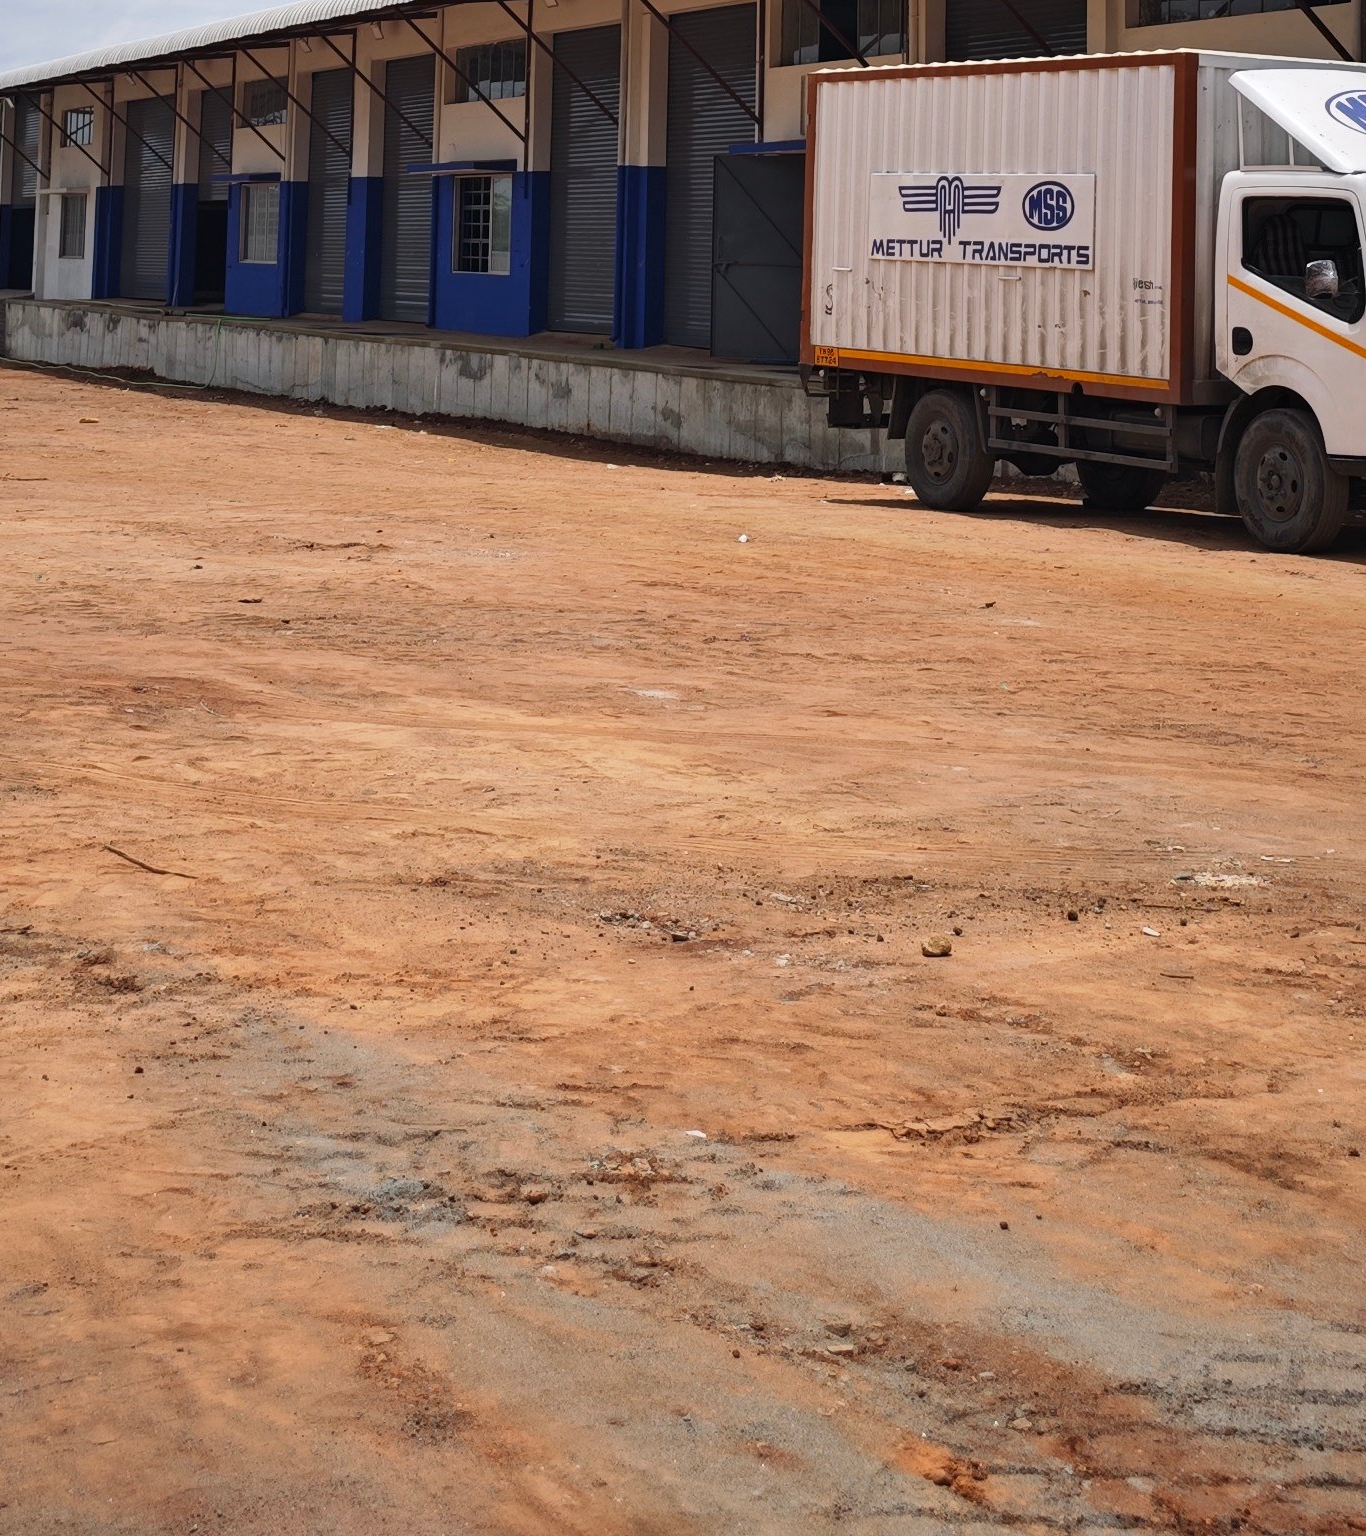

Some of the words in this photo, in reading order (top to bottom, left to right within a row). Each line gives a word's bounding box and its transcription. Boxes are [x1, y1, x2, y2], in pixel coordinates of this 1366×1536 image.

[1028, 187, 1068, 226] MSS
[870, 238, 944, 259] METTUR
[958, 240, 1090, 265] TRANSPORTS
